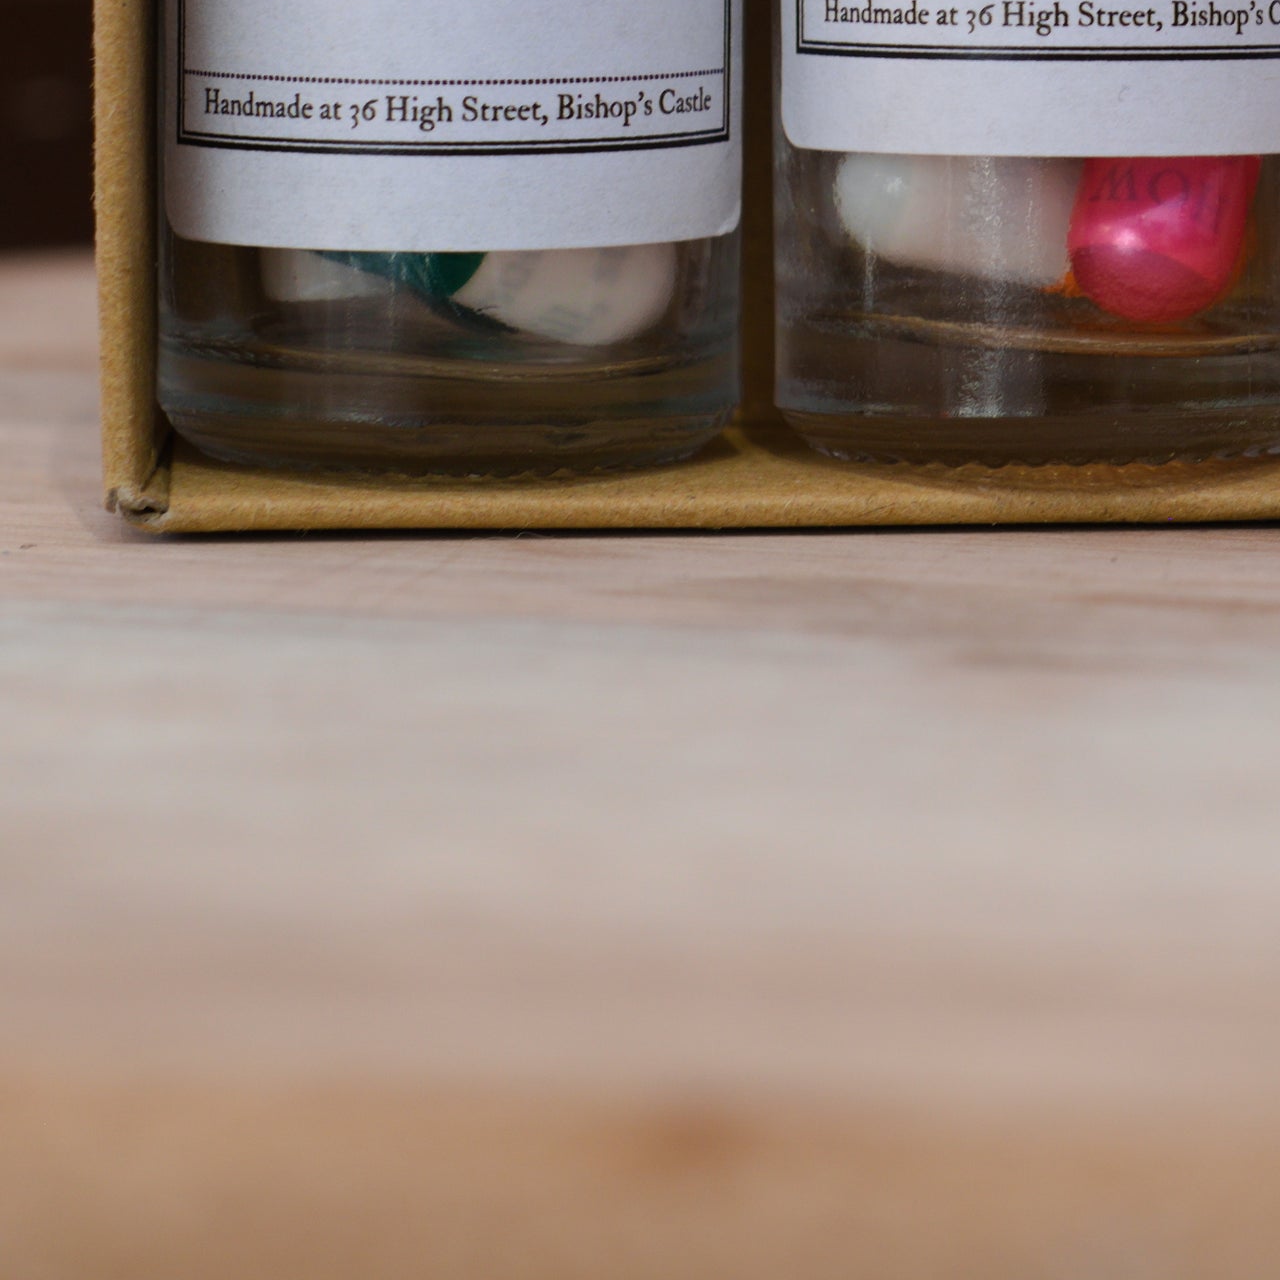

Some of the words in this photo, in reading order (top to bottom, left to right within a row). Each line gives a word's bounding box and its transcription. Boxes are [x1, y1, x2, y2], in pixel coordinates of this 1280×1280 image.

[936, 7, 958, 27] at
[966, 4, 995, 34] 36
[1002, 0, 1070, 37] High
[1078, 0, 1163, 32] Street,
[1171, 0, 1264, 35] Bishop's
[204, 87, 314, 120] Handmade
[319, 99, 342, 121] at
[350, 99, 379, 129] 36
[385, 95, 454, 132] High
[462, 96, 549, 126] Street,
[556, 93, 653, 127] Bishop's
[658, 86, 712, 116] Castle
